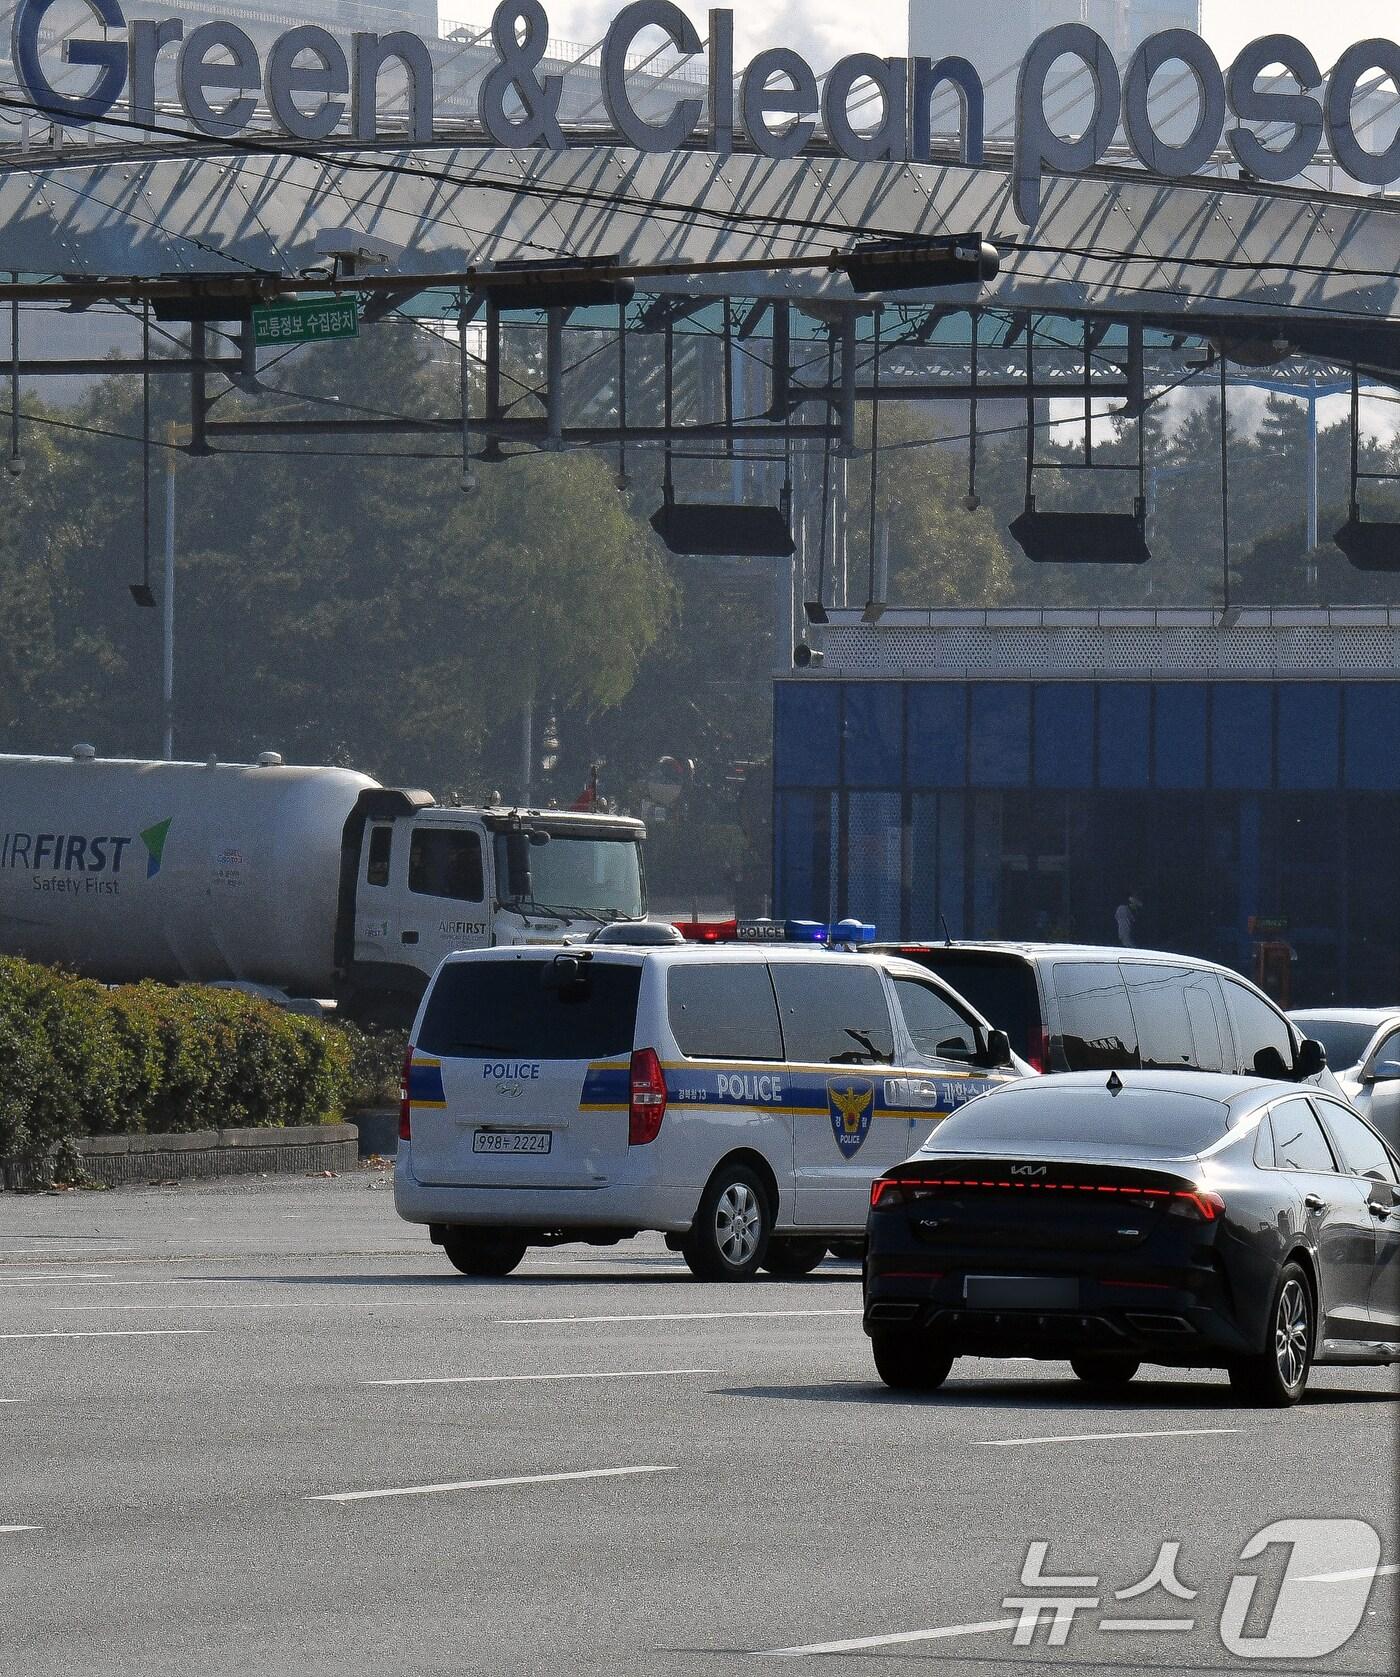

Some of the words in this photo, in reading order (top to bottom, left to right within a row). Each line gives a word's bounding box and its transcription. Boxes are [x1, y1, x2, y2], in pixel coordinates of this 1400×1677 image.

[11, 0, 433, 141] Green
[478, 0, 569, 150] &
[601, 0, 984, 164] Clean
[258, 315, 304, 337] 교통정보
[306, 310, 354, 333] 수집장치
[33, 876, 81, 895] Safety
[86, 878, 120, 895] First
[439, 922, 487, 934] AIRFIRST
[740, 926, 784, 938] POLICE
[483, 1064, 540, 1079] POLICE
[717, 1074, 782, 1101] POLICE
[840, 1135, 860, 1144] POLICE
